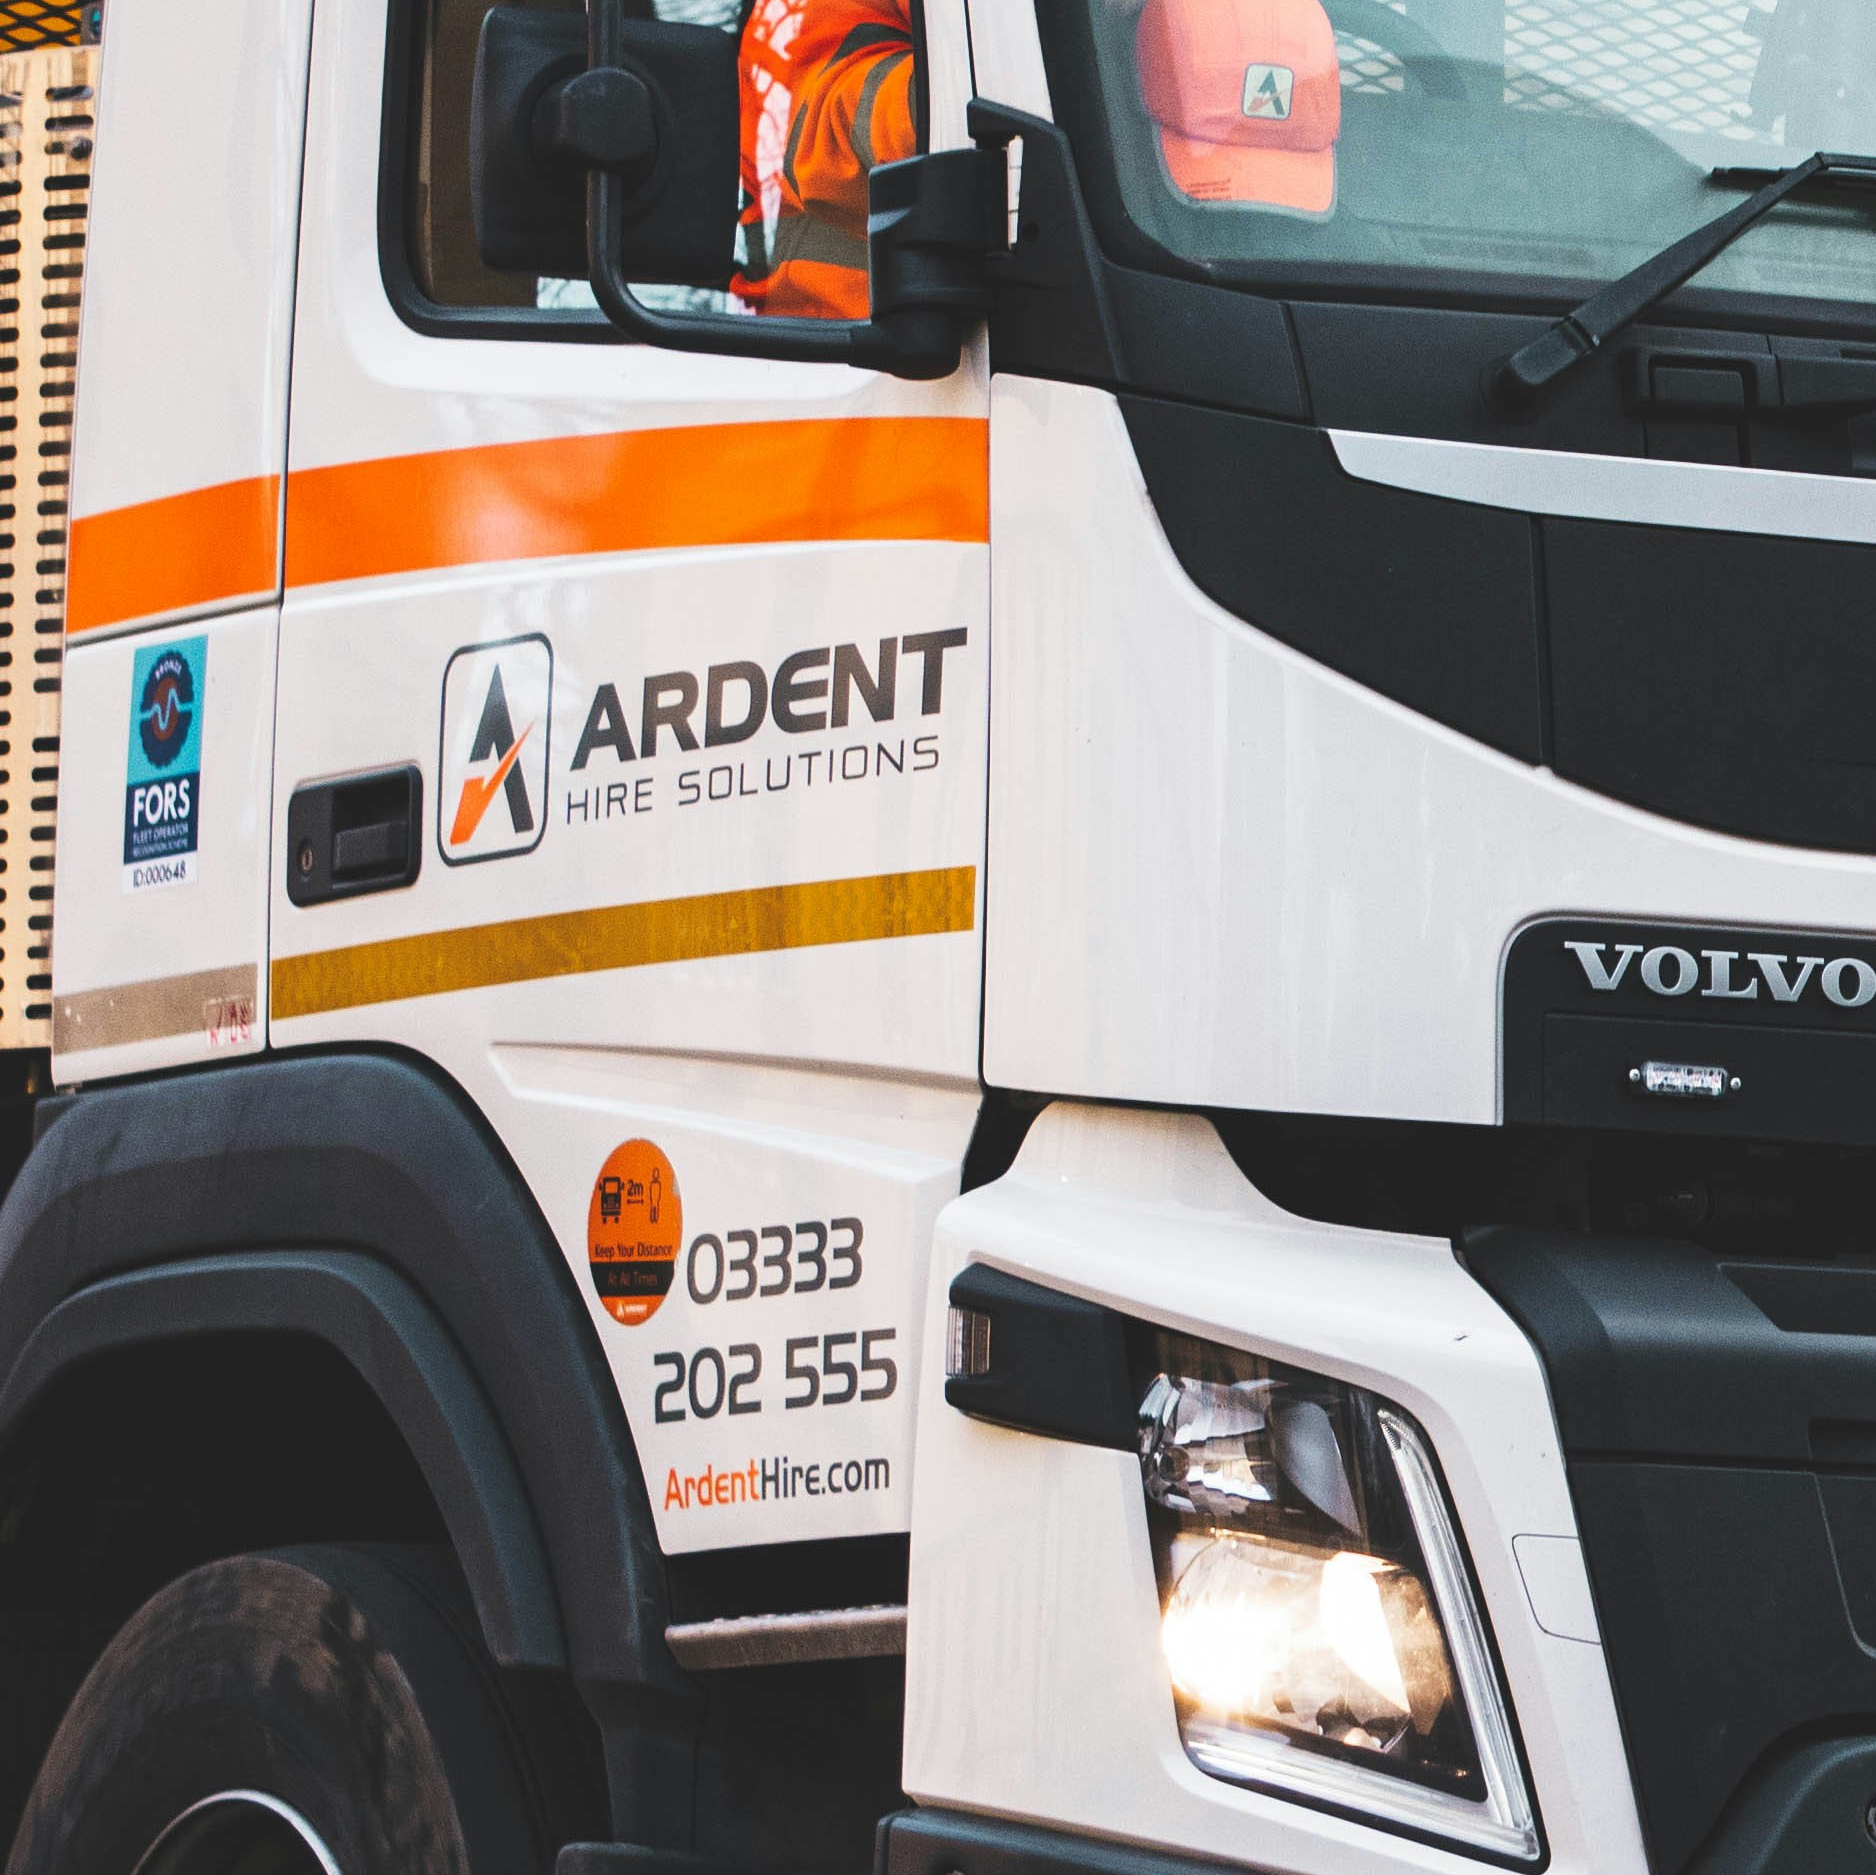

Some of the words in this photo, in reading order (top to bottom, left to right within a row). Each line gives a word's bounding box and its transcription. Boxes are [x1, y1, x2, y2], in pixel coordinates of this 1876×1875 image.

[569, 626, 969, 772] ARDENT
[133, 779, 190, 827] FORS
[566, 777, 653, 826] HIRE
[677, 735, 940, 806] SOLUTIONS
[594, 1243, 615, 1260] Keep
[617, 1241, 635, 1257] Your
[637, 1241, 673, 1257] Distance
[686, 1216, 864, 1305] 03333
[653, 1343, 763, 1424] 202
[785, 1327, 898, 1410] 555
[664, 1455, 891, 1512] ArdentHire.com
